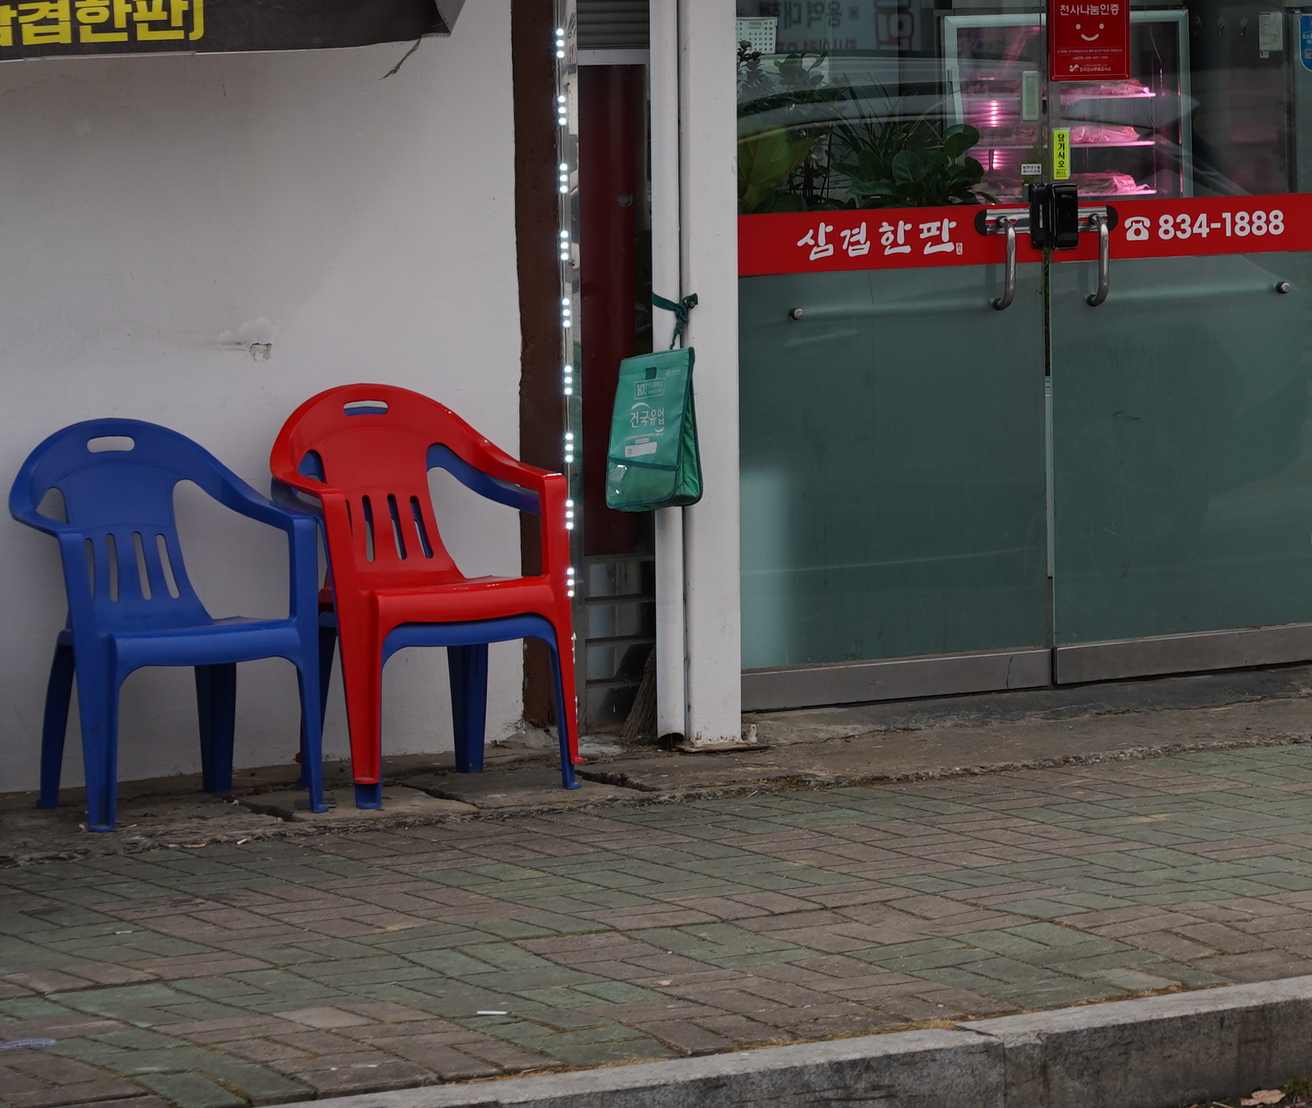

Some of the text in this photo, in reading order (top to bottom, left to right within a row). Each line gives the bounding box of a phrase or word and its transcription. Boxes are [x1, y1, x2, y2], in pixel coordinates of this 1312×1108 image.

[1060, 3, 1120, 16] 천사나눔인증
[1057, 134, 1065, 168] 당기시오
[1158, 210, 1285, 240] 834-1888
[630, 408, 665, 428] 건국유업
